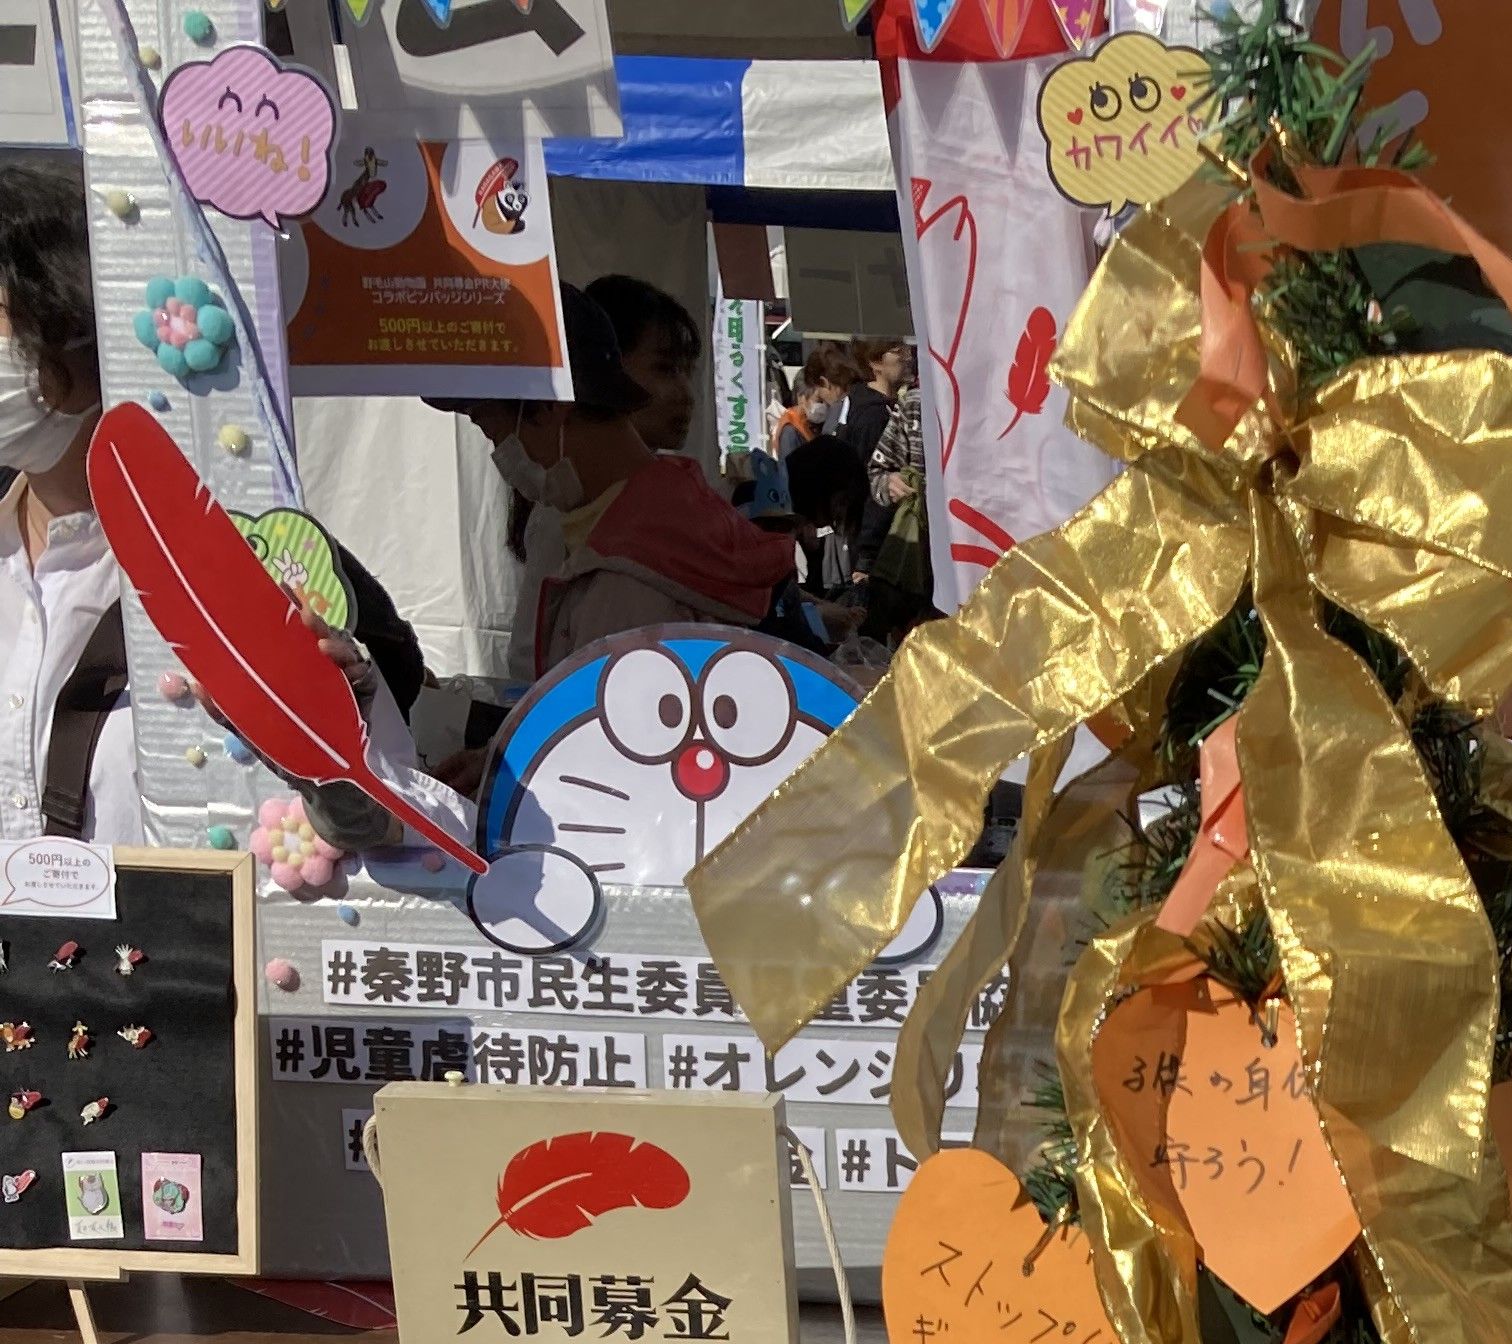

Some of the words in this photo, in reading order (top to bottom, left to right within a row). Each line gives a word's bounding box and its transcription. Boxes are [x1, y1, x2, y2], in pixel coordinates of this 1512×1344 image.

[28, 853, 91, 867] 500円以上の
[275, 1022, 637, 1089] #児童虐待防止
[453, 1270, 734, 1342] 共同募金
